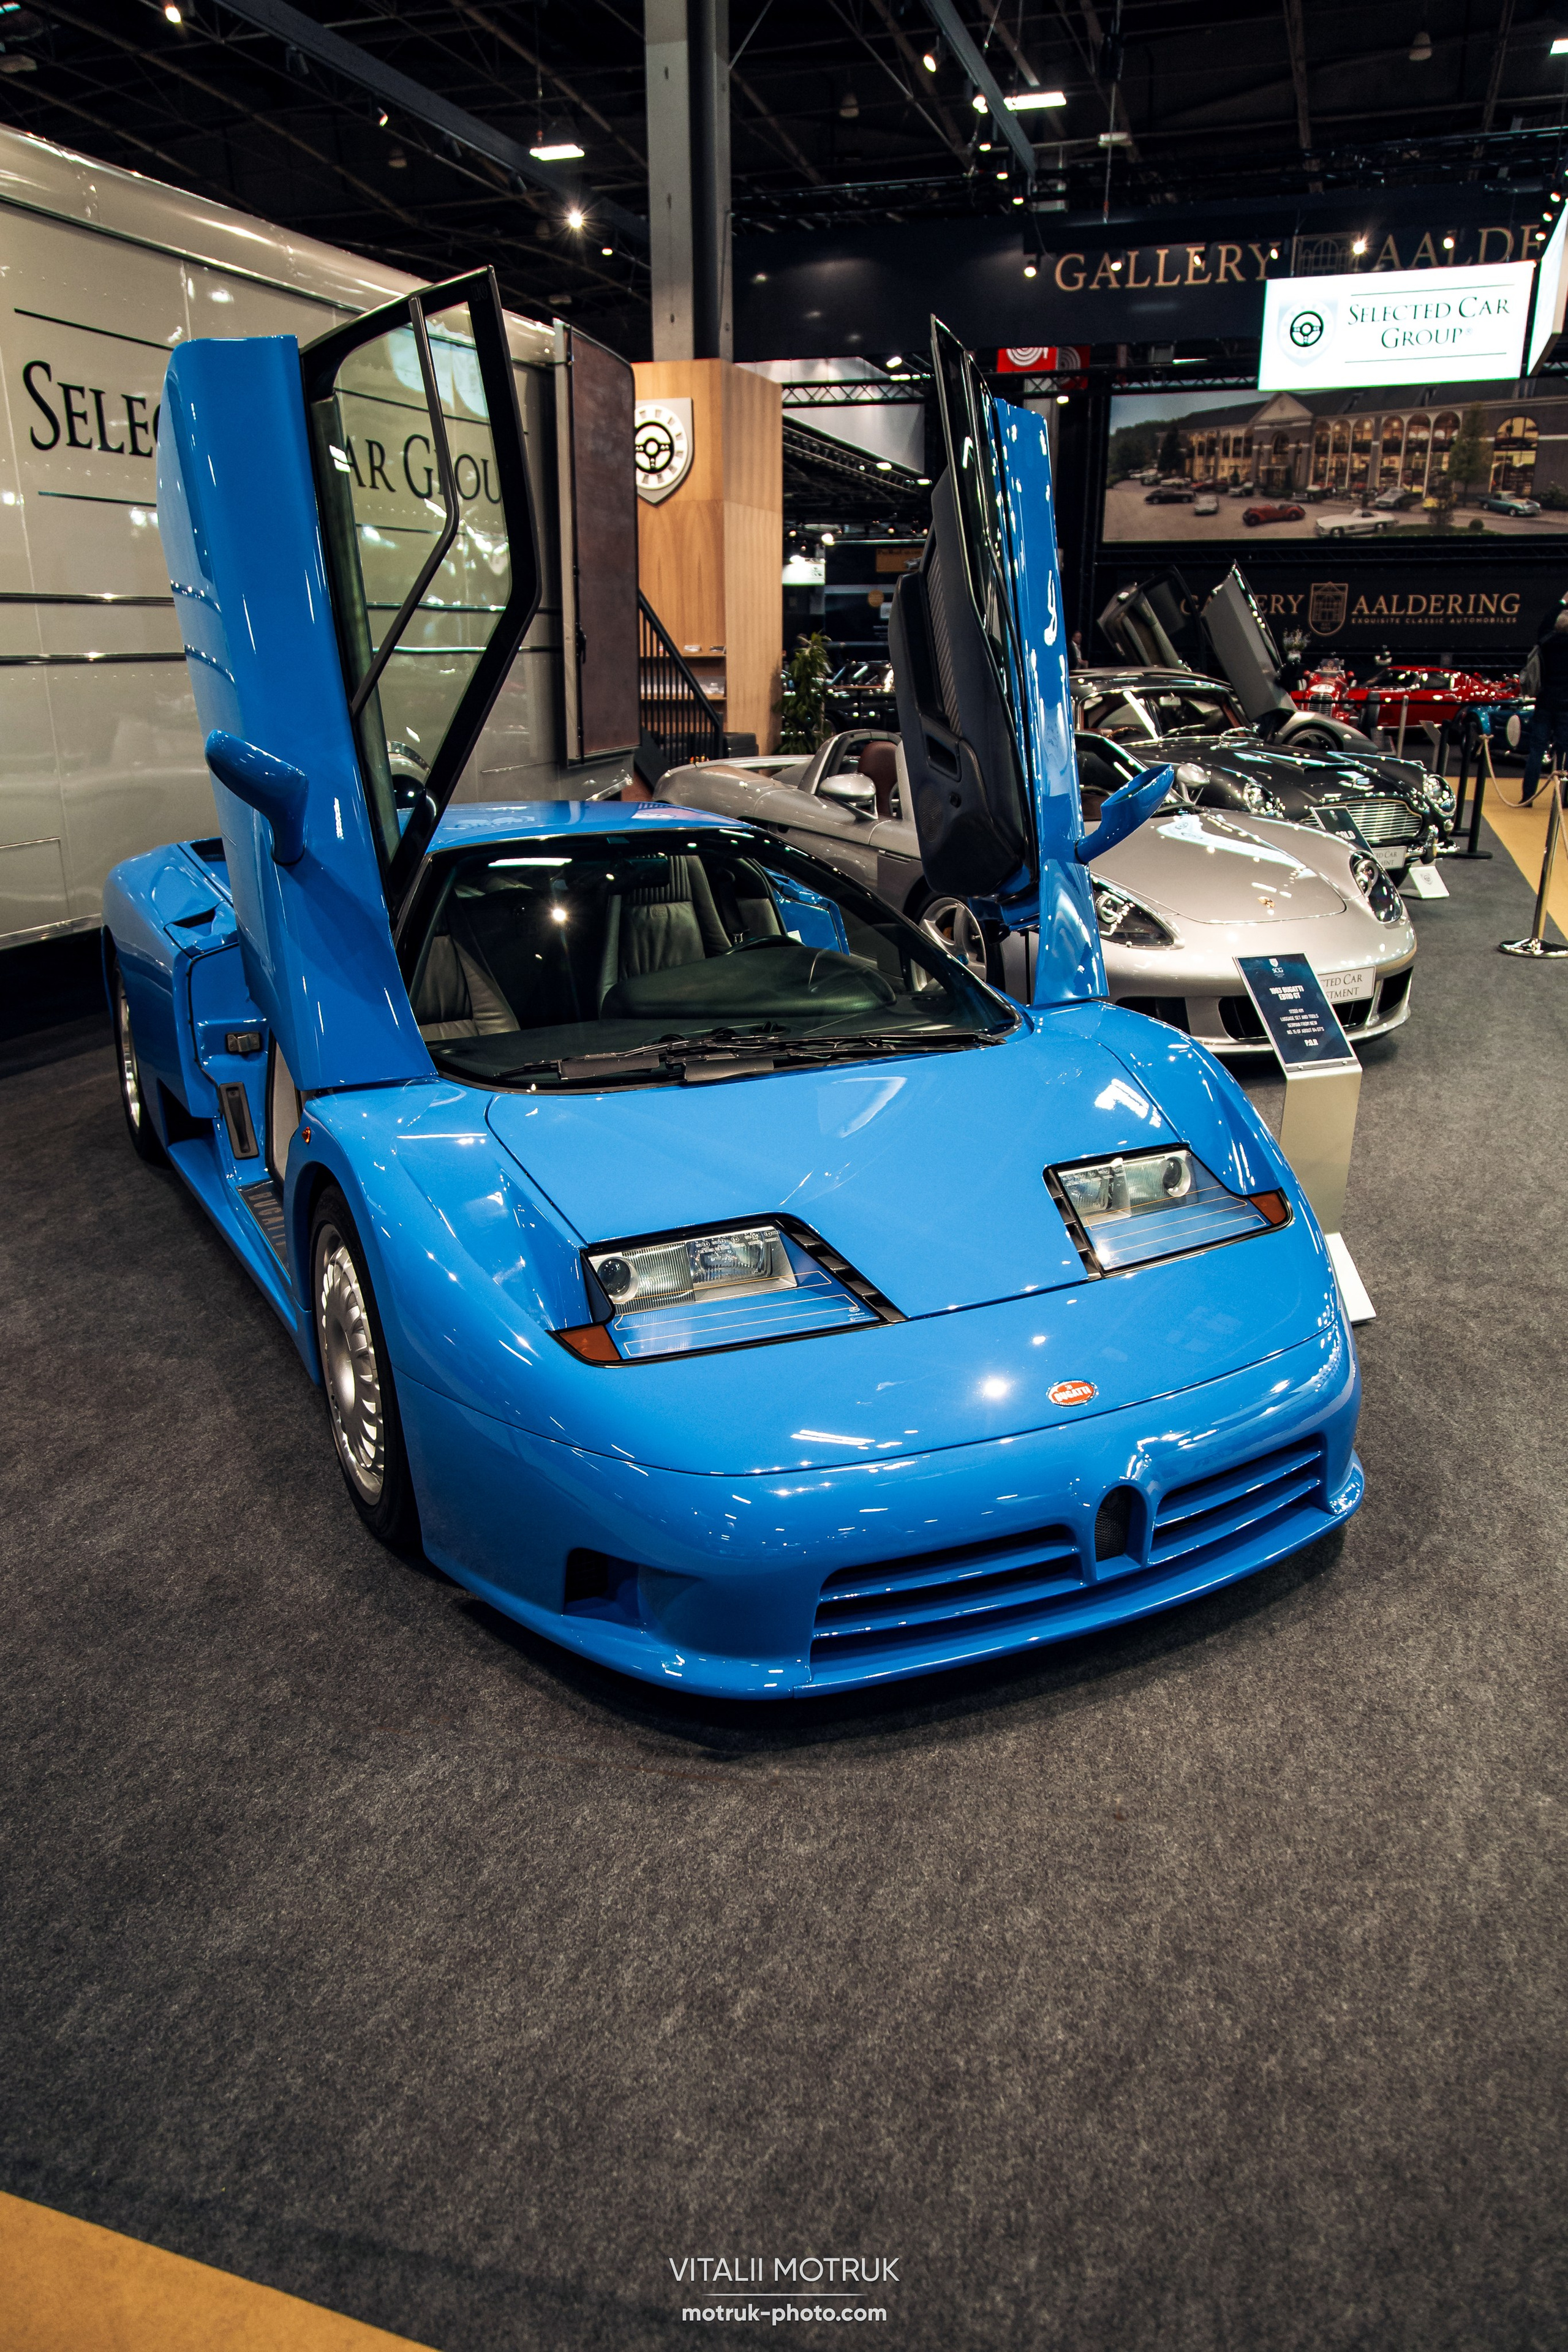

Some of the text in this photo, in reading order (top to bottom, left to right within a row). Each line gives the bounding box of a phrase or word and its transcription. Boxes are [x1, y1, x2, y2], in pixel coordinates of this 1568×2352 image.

[1055, 241, 1281, 292] GALLERY
[1348, 296, 1510, 325] SELECTED CAR
[1352, 593, 1521, 615] AALDERING
[1343, 974, 1363, 985] CAR
